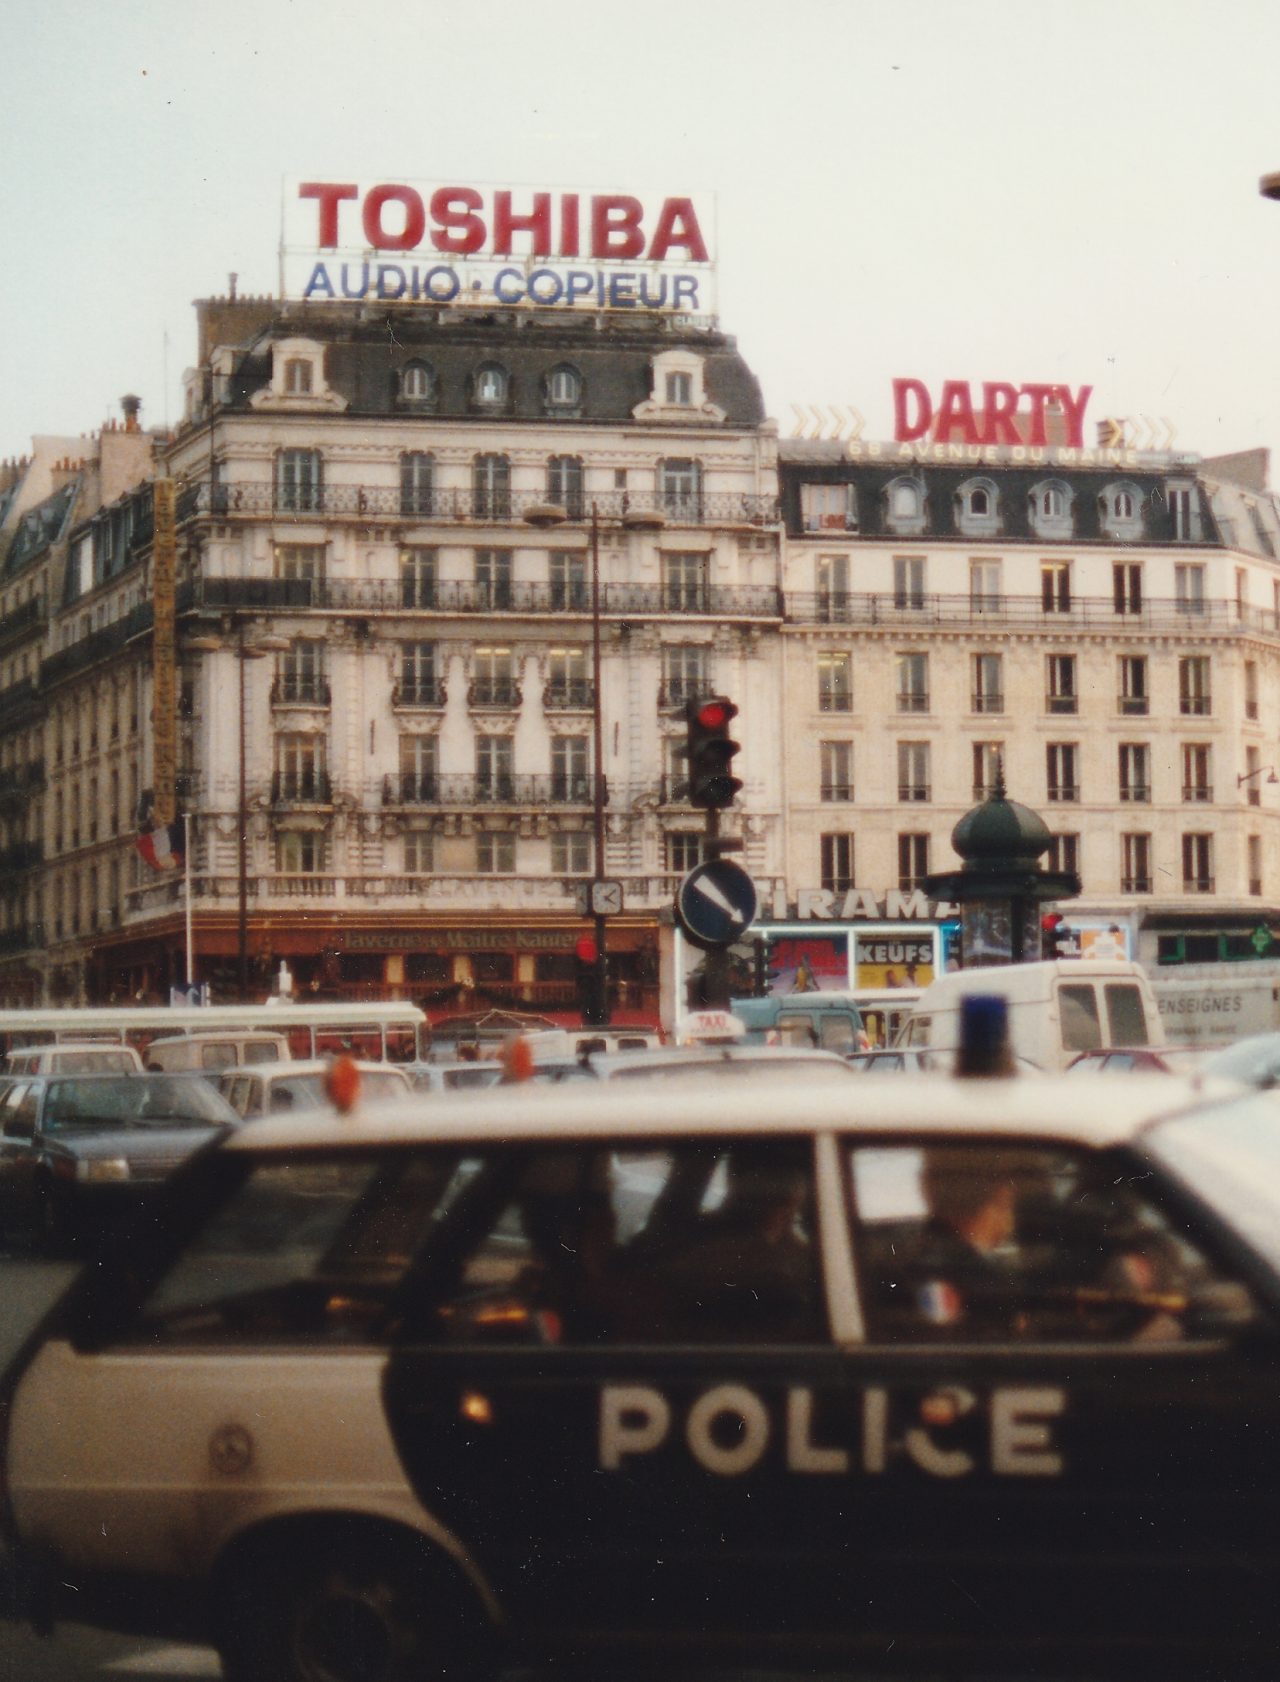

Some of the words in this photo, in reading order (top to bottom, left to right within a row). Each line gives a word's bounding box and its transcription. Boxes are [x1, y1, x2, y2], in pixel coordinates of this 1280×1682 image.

[298, 183, 709, 262] TOSHIBA
[305, 262, 461, 300] AUDIO
[493, 268, 700, 310] COPIEUR
[892, 378, 1094, 448] DARTY
[899, 442, 997, 460] AVENUE
[1012, 446, 1044, 461] DU
[1058, 447, 1137, 465] MAINE
[1158, 996, 1242, 1015] ENSEIGNES
[600, 1385, 1065, 1477] POLICE
